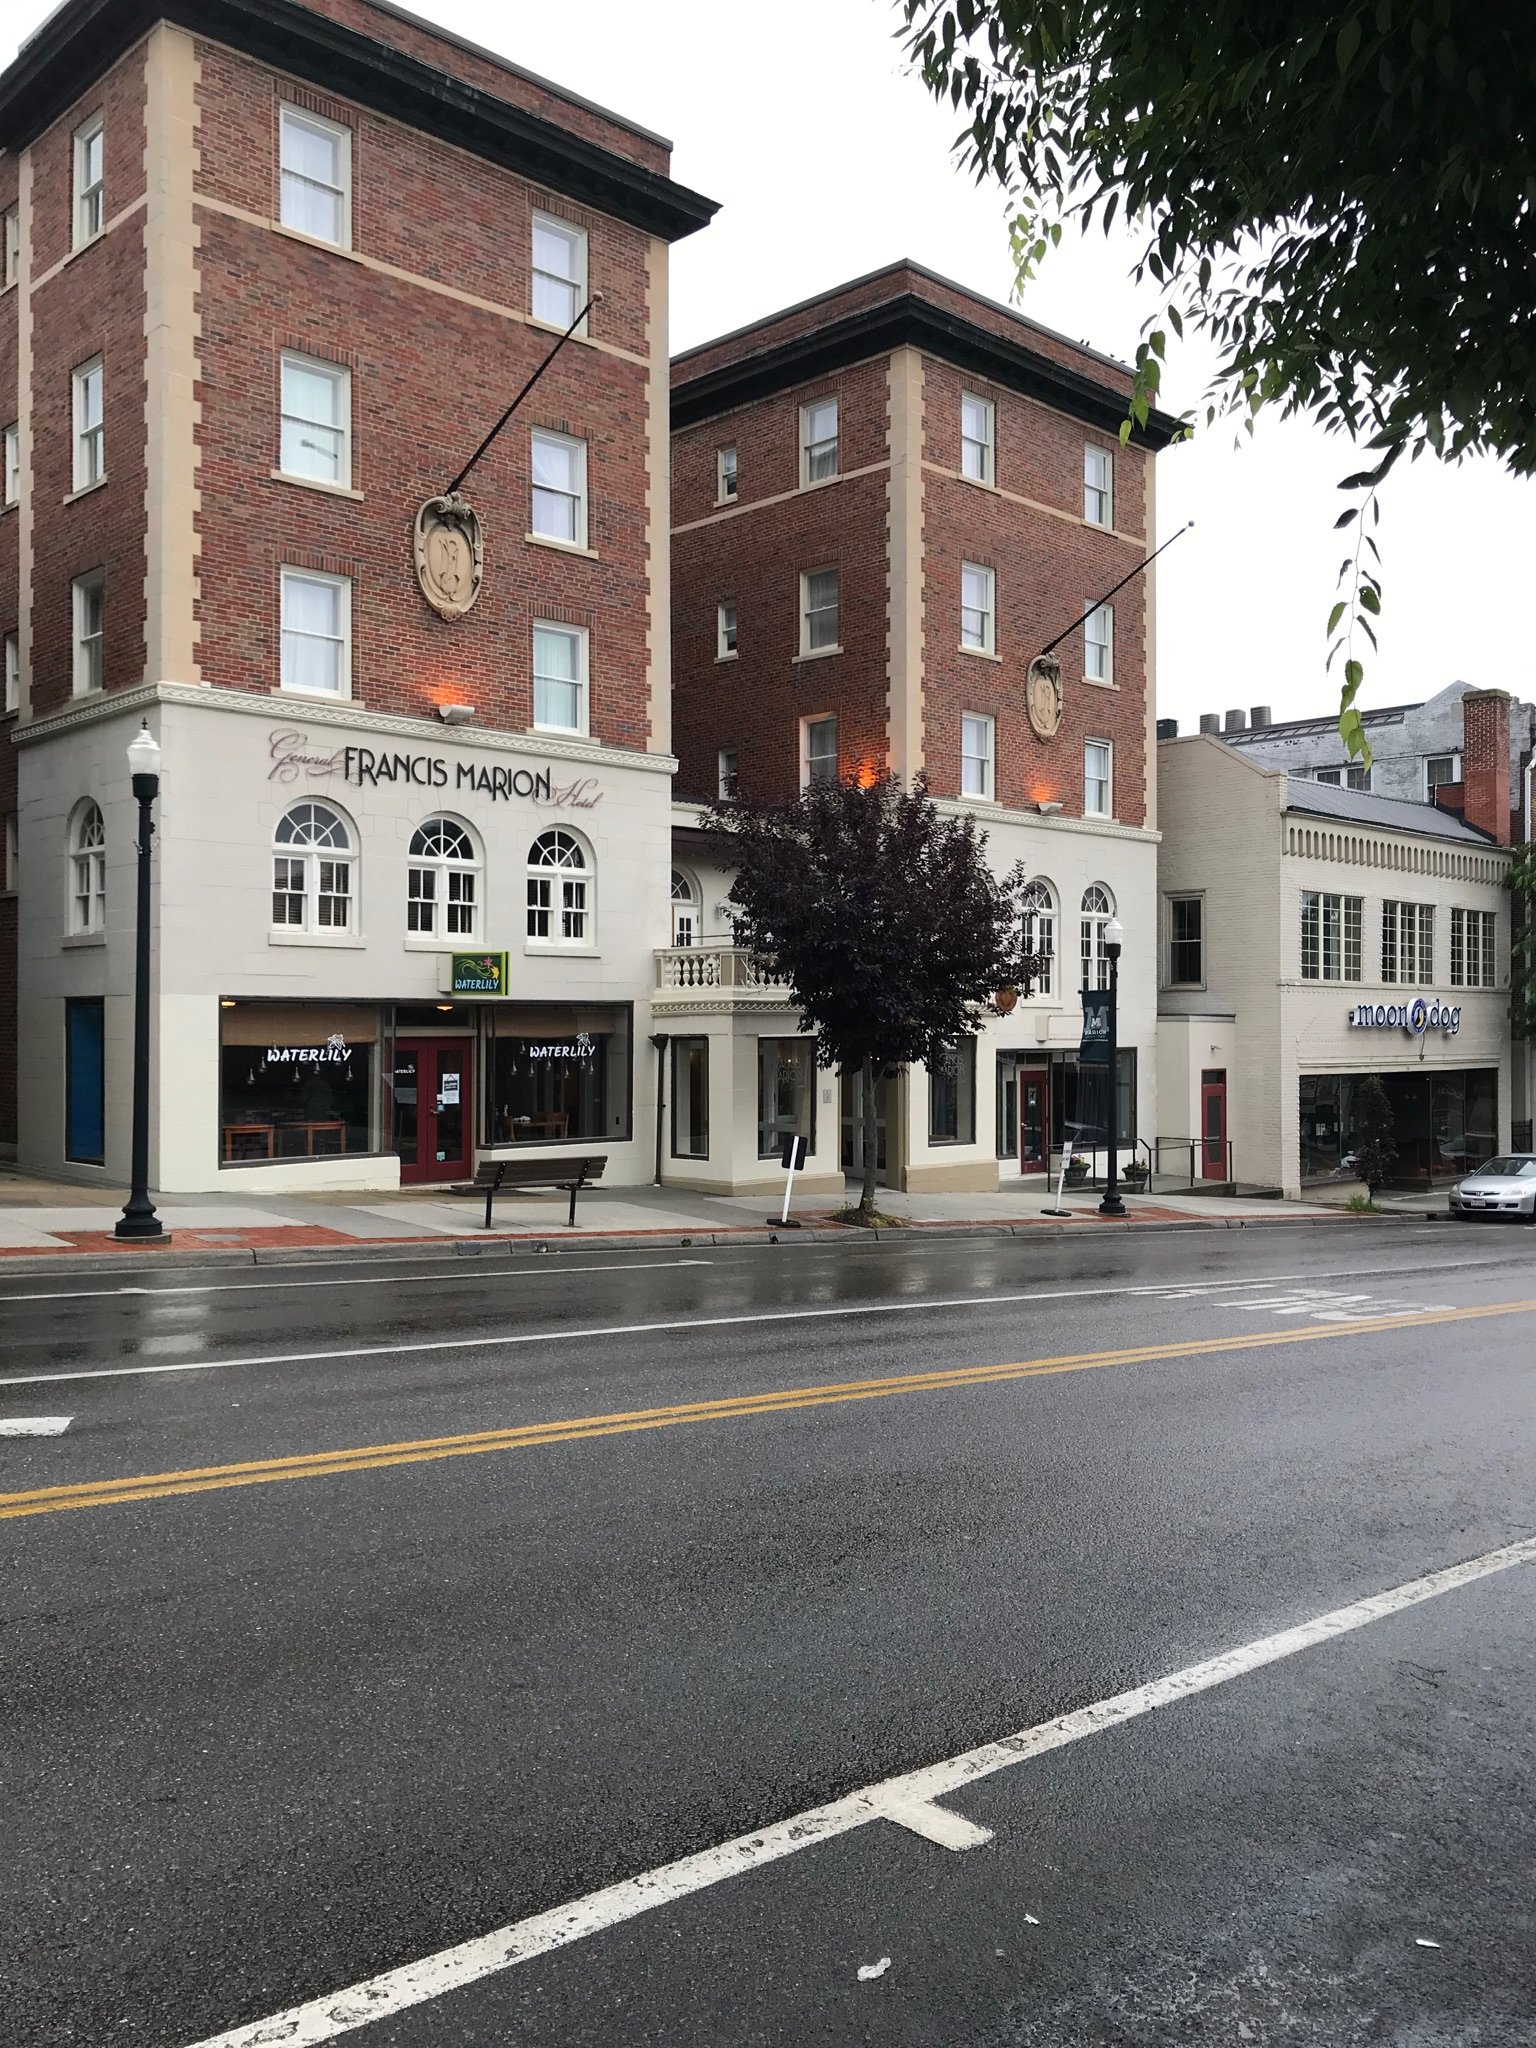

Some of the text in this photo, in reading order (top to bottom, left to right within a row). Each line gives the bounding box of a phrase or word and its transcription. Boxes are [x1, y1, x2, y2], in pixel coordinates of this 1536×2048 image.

[268, 728, 604, 809] General FRANCIS MARION Hotel
[455, 979, 499, 990] WATERLILY
[1357, 1004, 1408, 1027] moon
[1430, 998, 1461, 1034] dog
[267, 1048, 352, 1062] WATERLILY
[529, 1045, 596, 1058] WATERLILY
